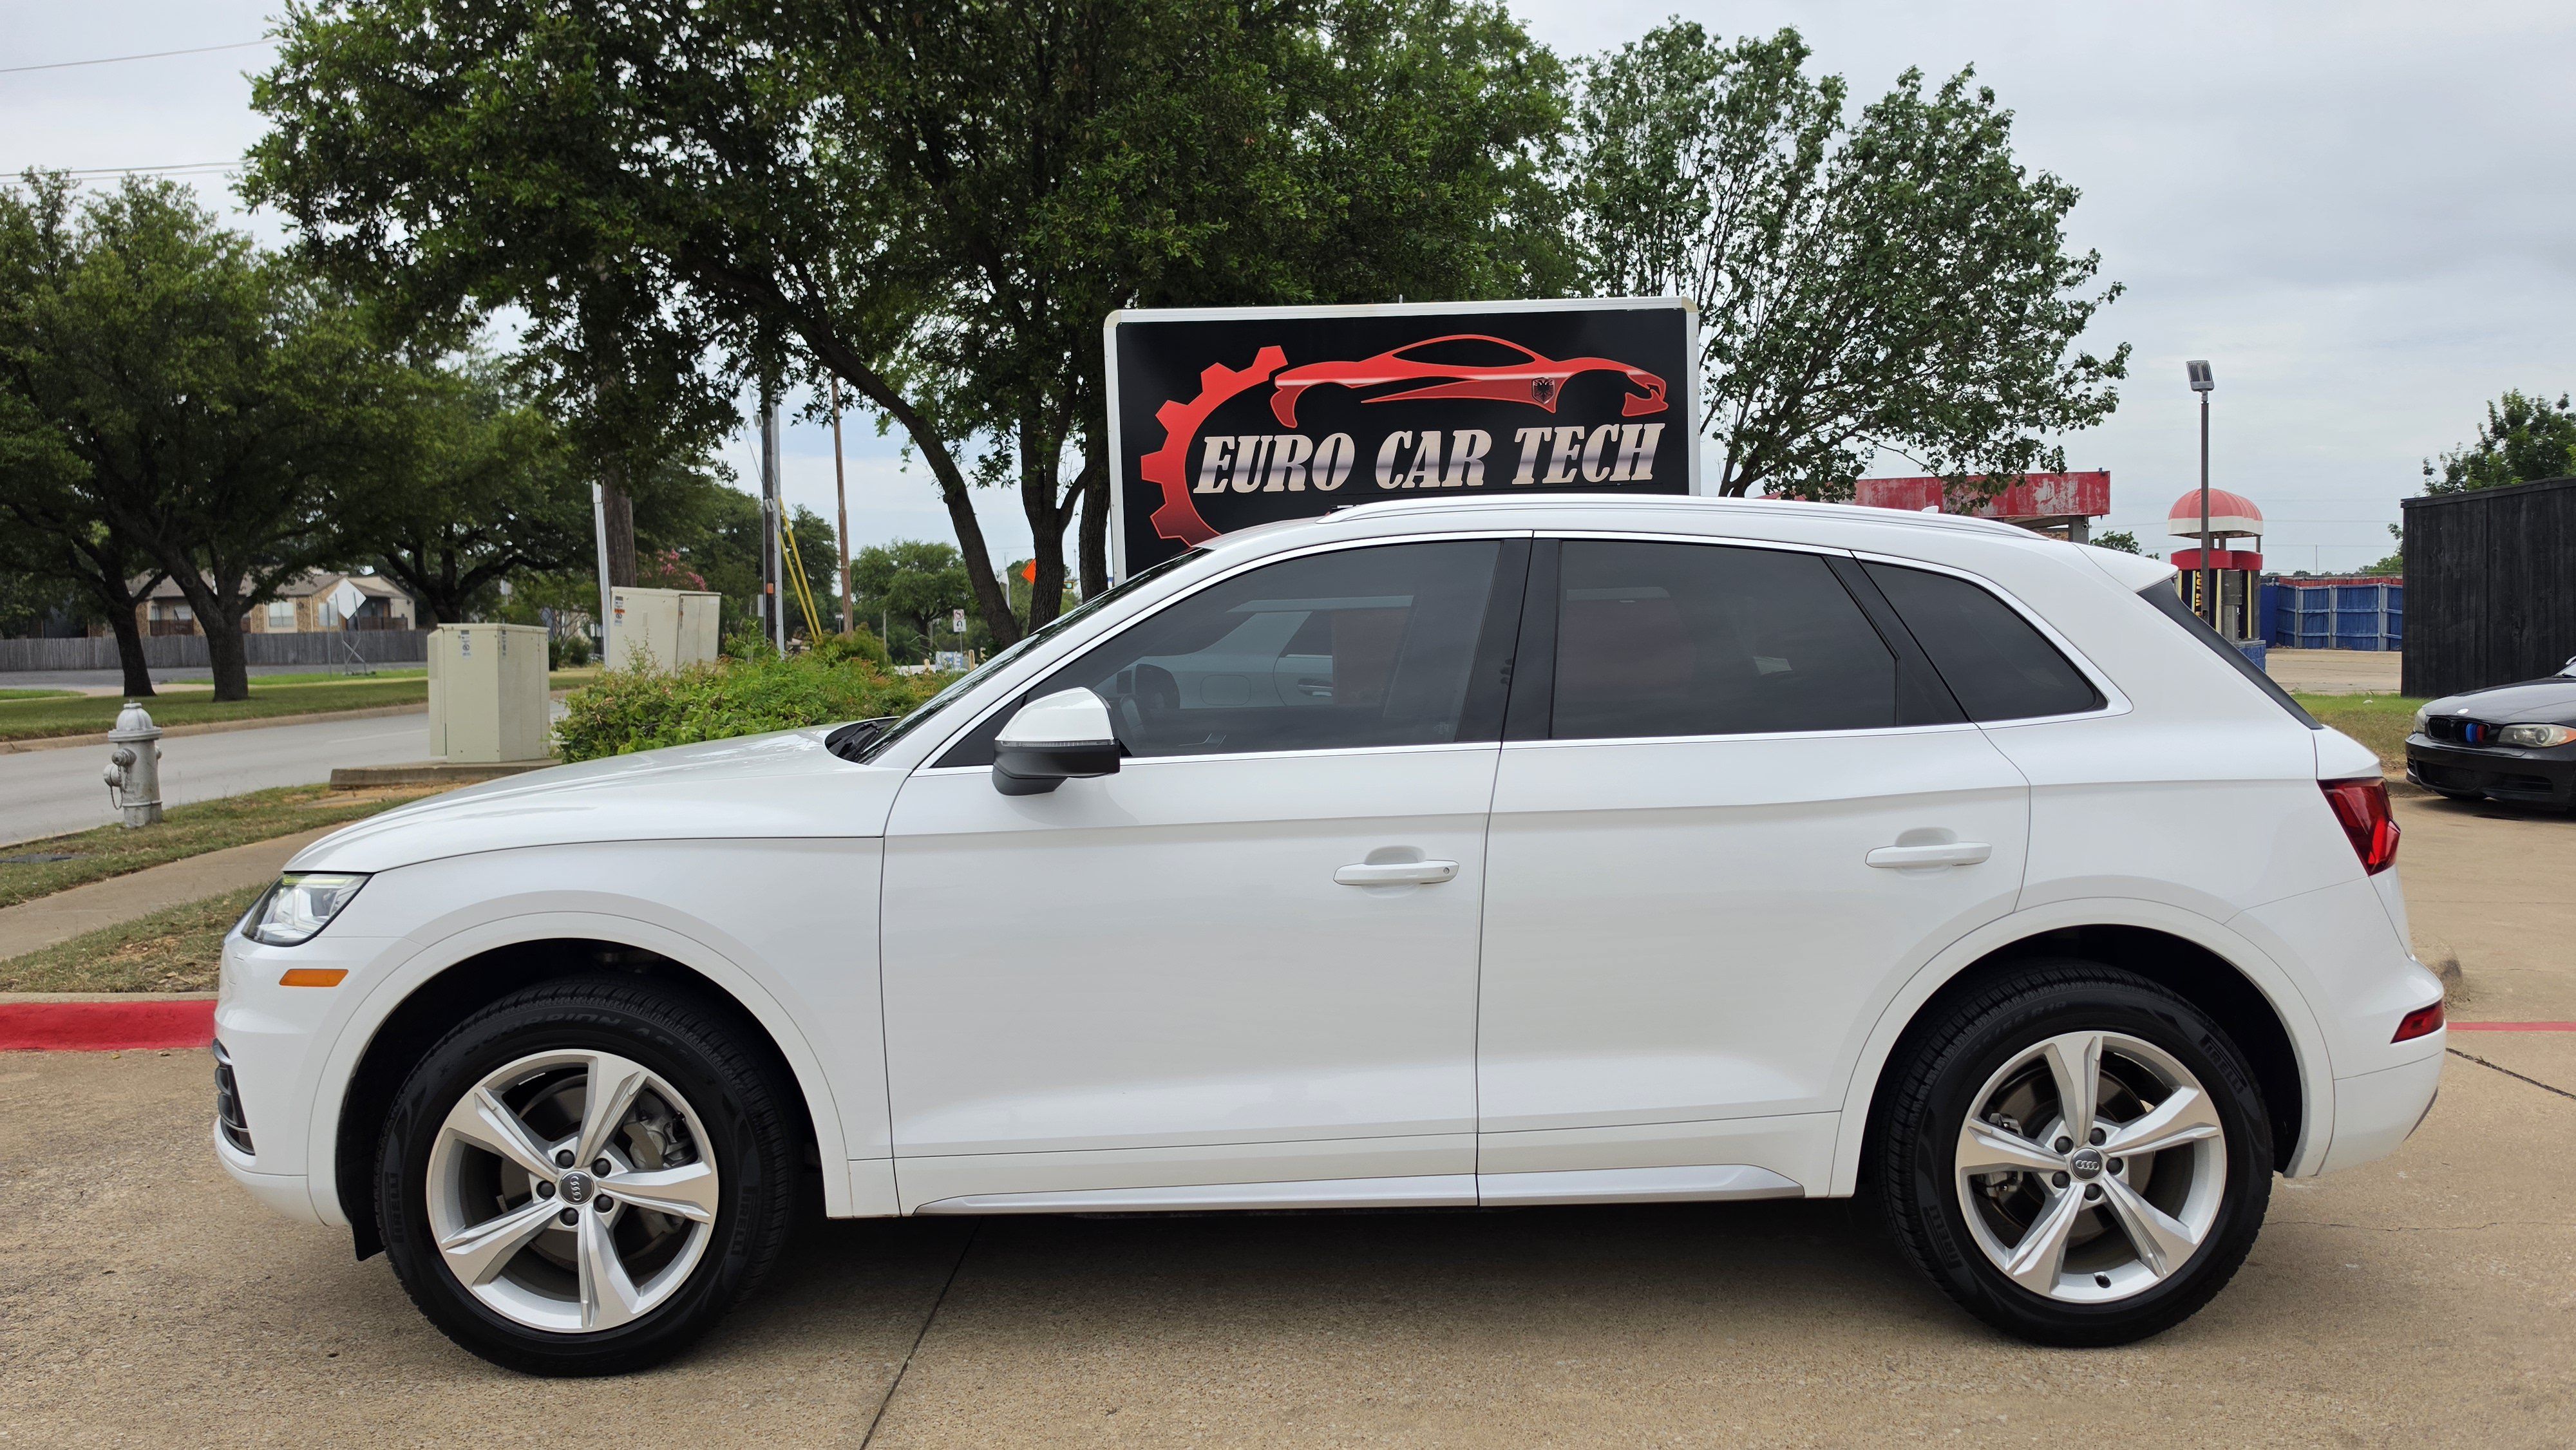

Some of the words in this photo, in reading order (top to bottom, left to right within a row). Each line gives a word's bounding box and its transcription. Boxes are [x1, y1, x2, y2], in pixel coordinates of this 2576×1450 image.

[1193, 432, 1355, 493] EURO
[1376, 429, 1492, 489] CAR
[1512, 423, 1665, 485] TECH
[2198, 1033, 2248, 1095] PIRELLI
[730, 1185, 758, 1256] PIRELLI
[1922, 1204, 1963, 1270] PIRELLI
